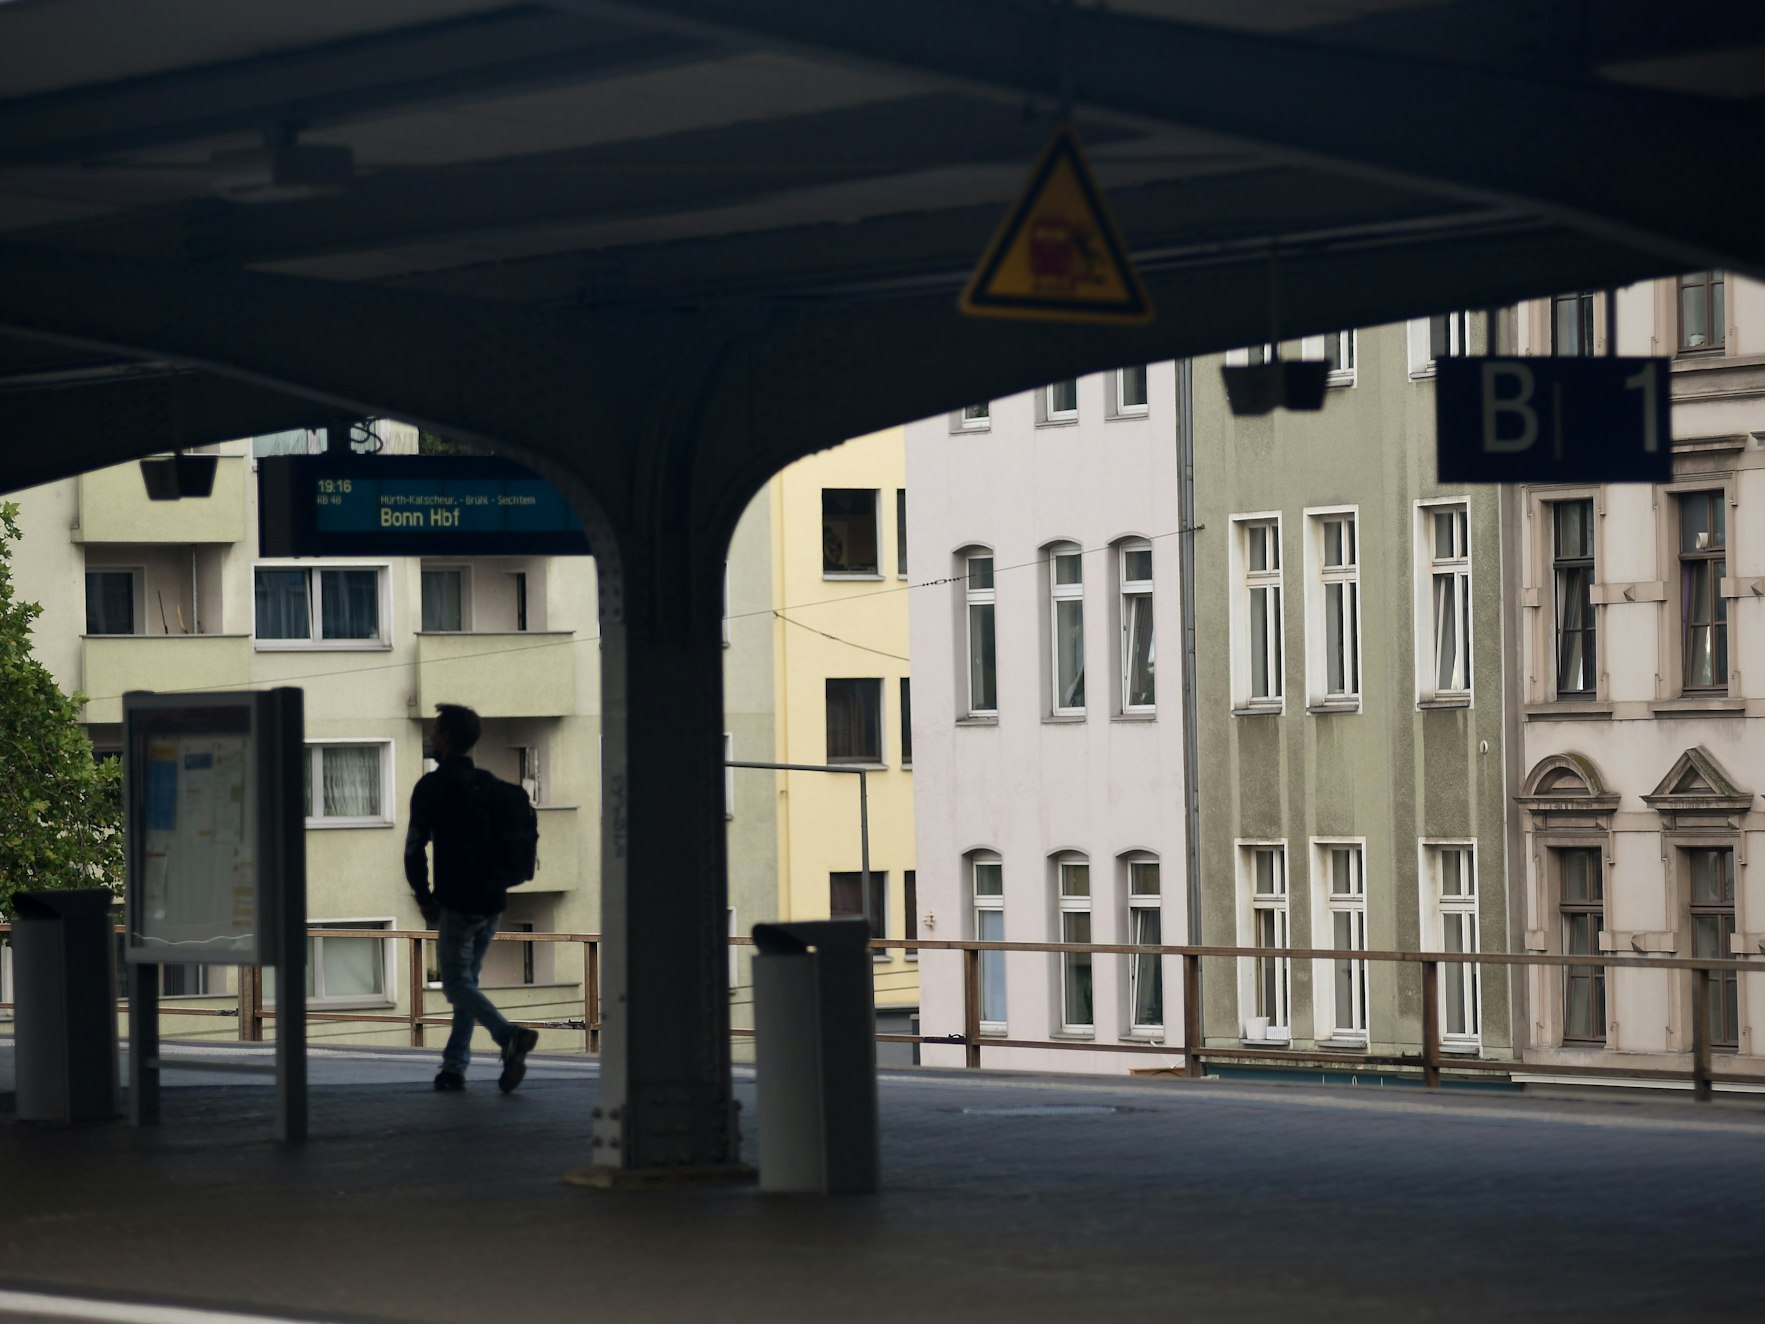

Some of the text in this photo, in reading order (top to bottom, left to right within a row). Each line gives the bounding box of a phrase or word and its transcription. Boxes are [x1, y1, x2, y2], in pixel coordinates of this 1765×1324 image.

[1482, 361, 1659, 453] B 1
[318, 479, 352, 493] 19:16
[317, 495, 342, 505] RB 48
[465, 495, 488, 505] Brühl
[497, 495, 536, 505] Sechtem
[380, 508, 460, 527] Bonn Hbf
